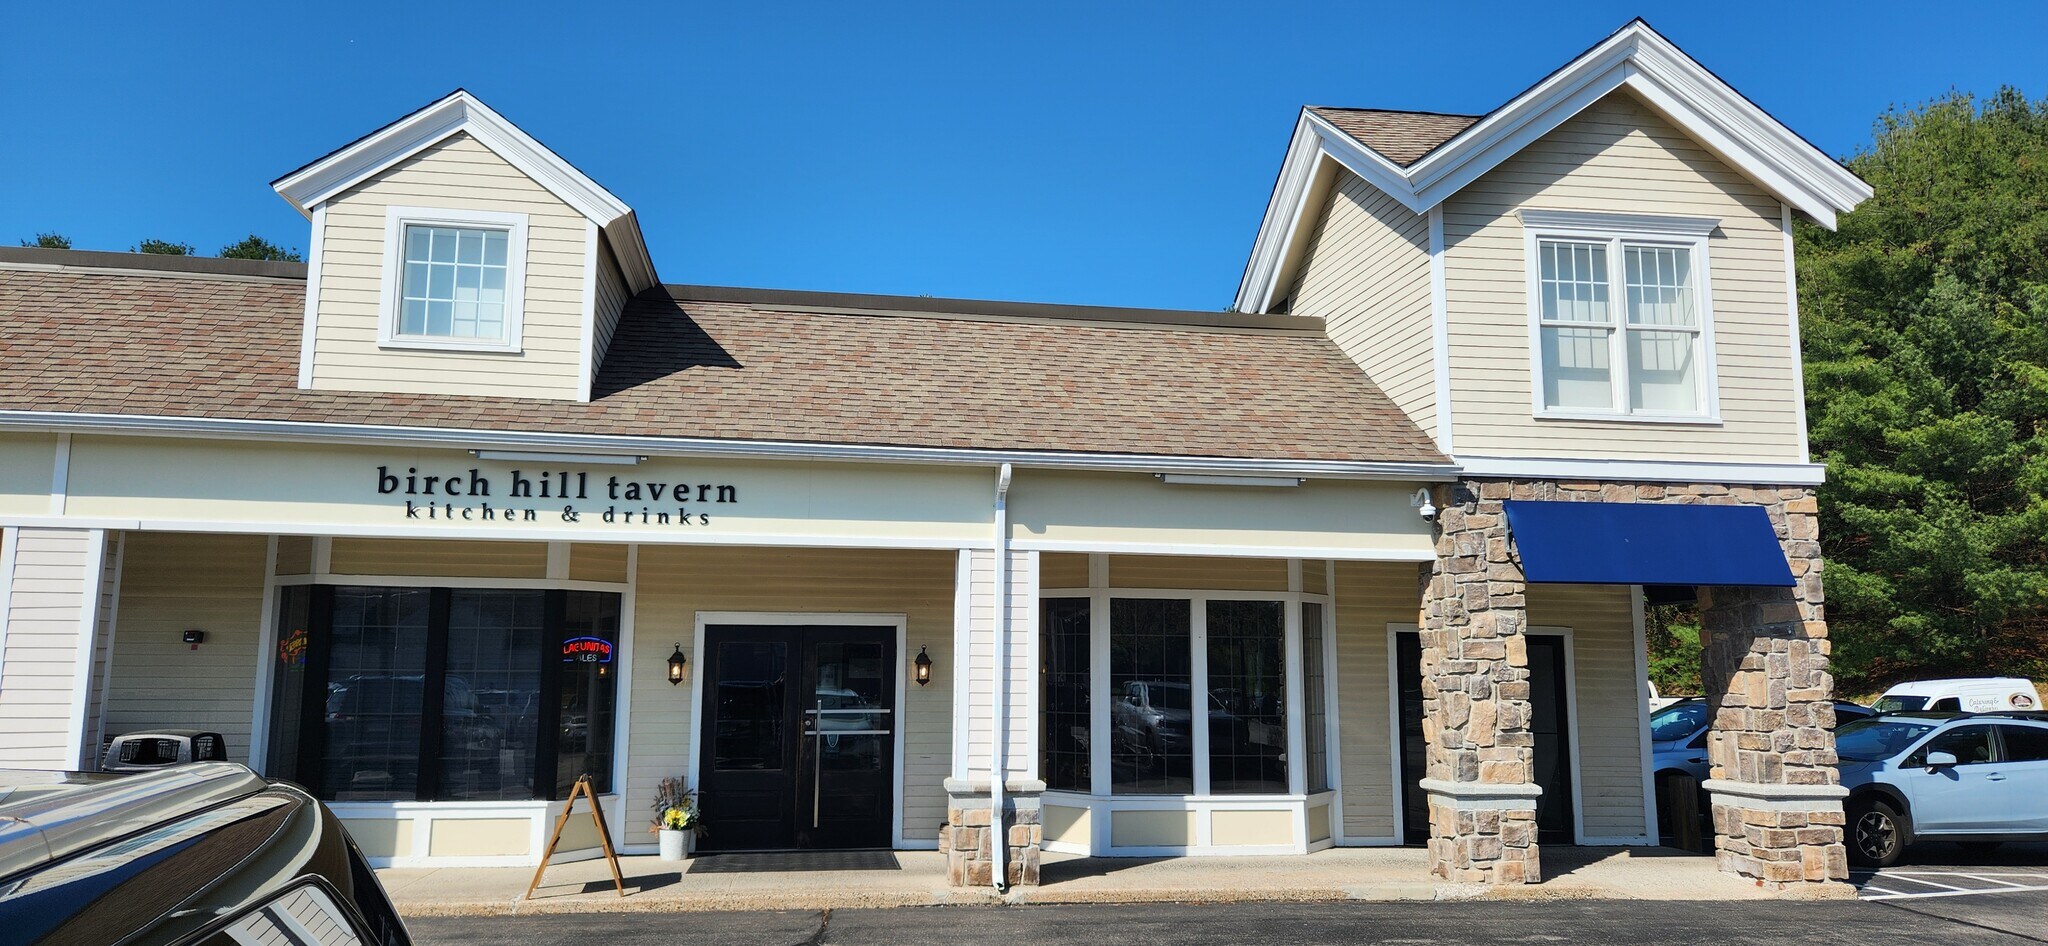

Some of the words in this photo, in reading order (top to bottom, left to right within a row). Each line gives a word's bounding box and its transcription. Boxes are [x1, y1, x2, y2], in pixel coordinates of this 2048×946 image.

[377, 466, 490, 497] birch
[510, 470, 588, 499] hill
[607, 475, 738, 503] tavern
[405, 501, 537, 522] kitchen
[561, 505, 582, 523] &
[603, 506, 710, 527] drinks
